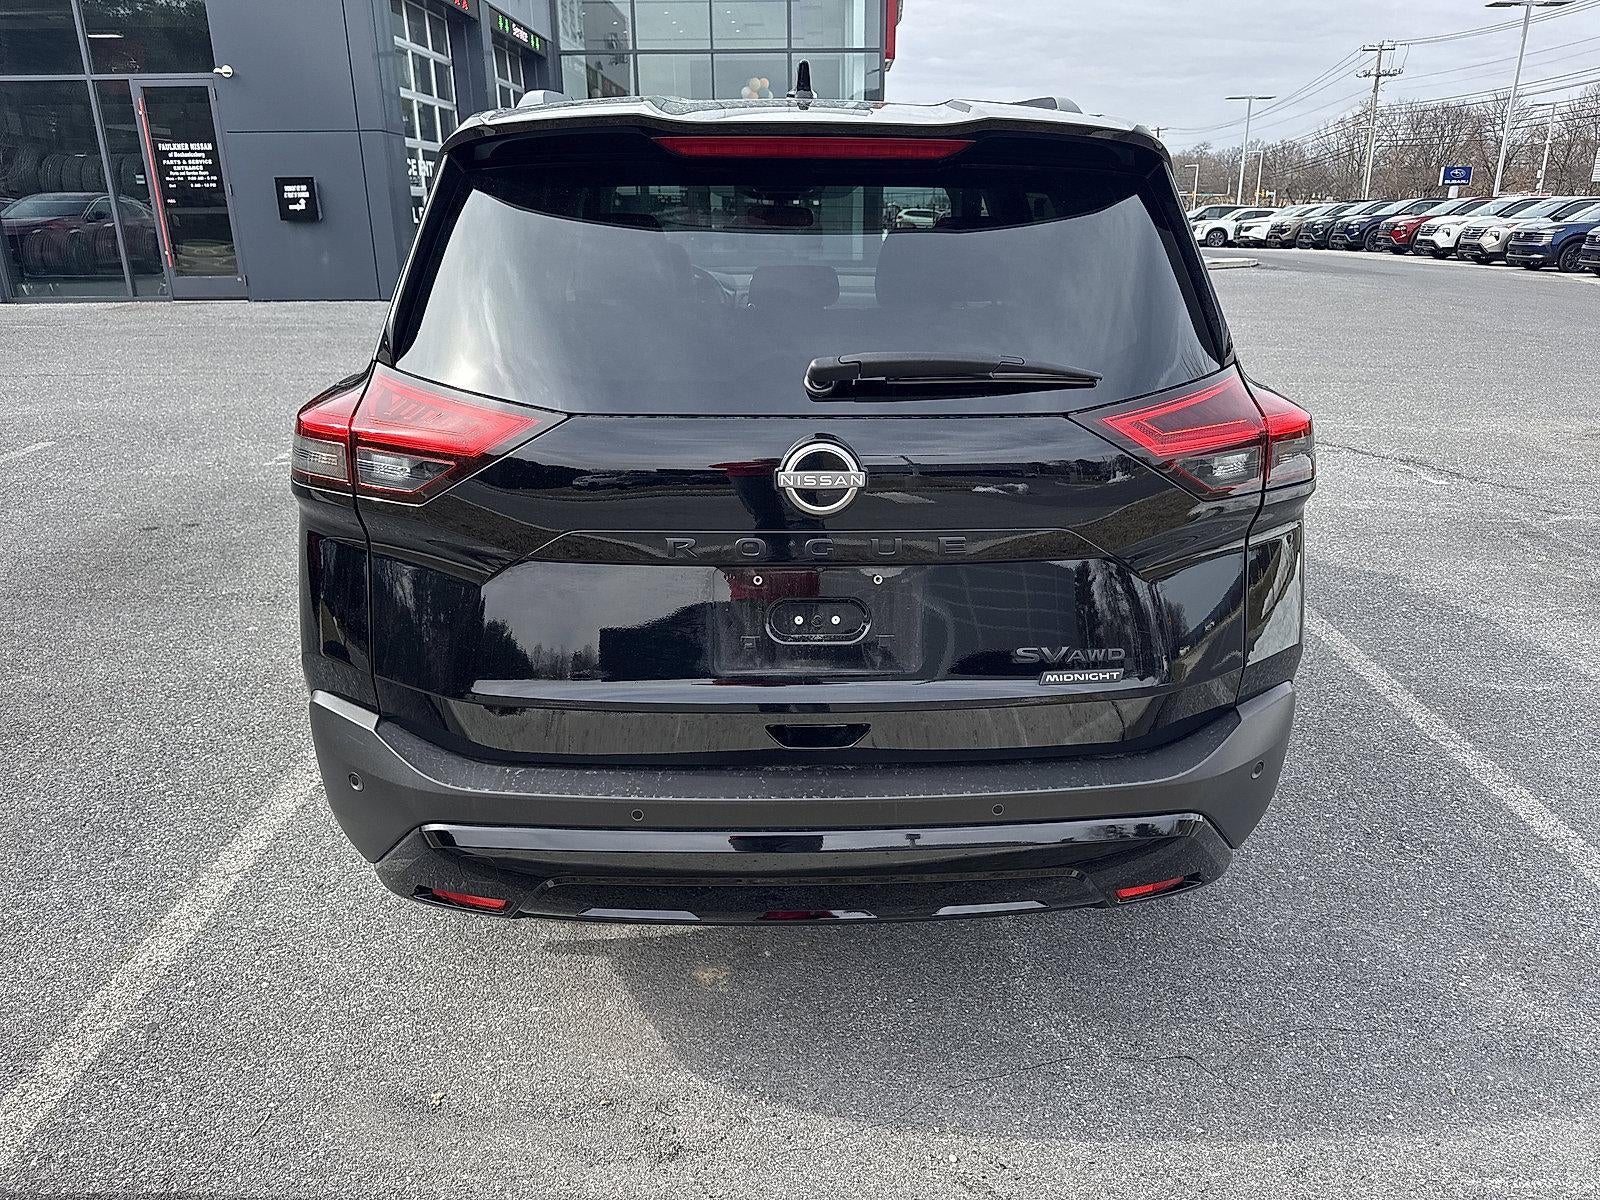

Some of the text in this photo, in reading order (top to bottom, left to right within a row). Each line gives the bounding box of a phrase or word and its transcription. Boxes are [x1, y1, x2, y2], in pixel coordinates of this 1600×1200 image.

[190, 142, 213, 150] NISSAN
[779, 474, 865, 487] NISSAN
[665, 536, 967, 558] ROGUE
[1045, 671, 1120, 682] MIDNIGHT
